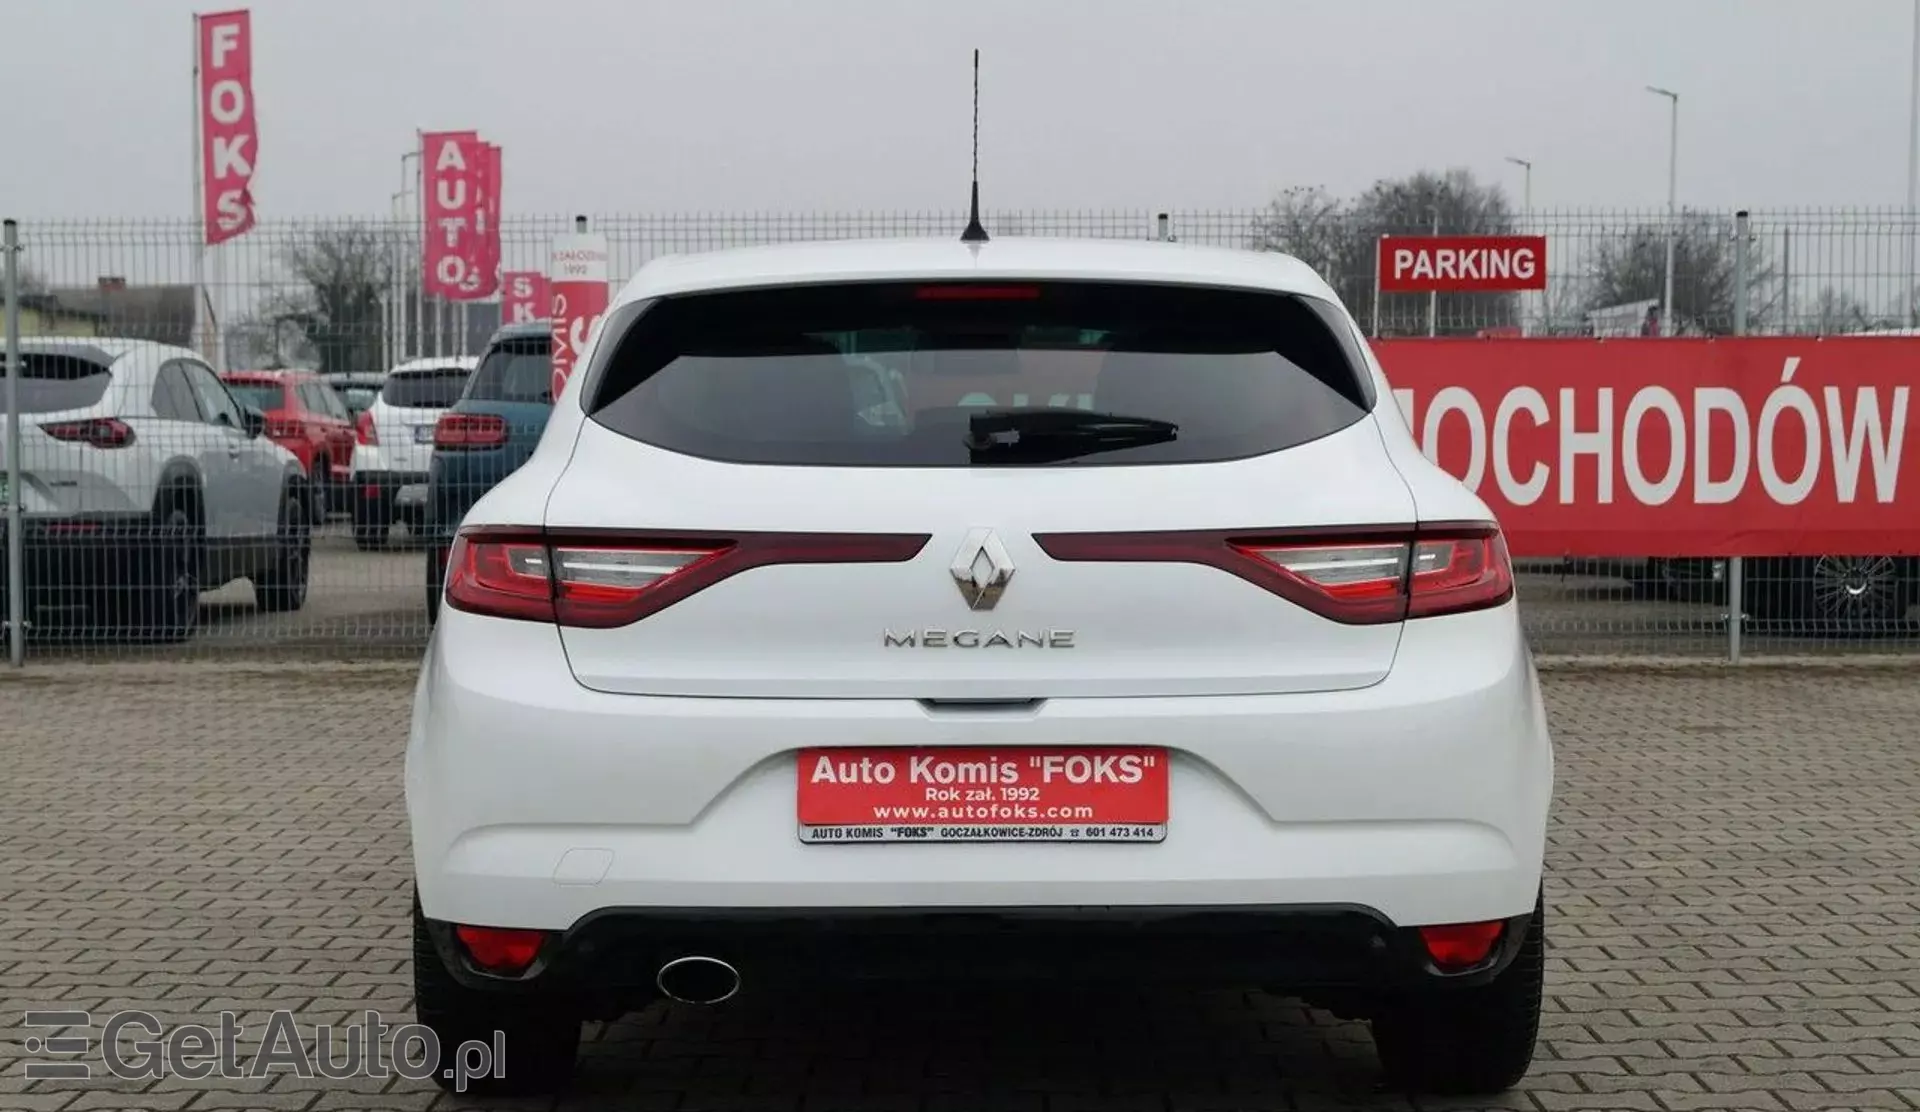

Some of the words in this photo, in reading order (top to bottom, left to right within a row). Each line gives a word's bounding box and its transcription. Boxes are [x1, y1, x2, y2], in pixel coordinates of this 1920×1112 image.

[210, 24, 252, 231] FOKS
[436, 139, 467, 284] AUTO
[1393, 248, 1536, 280] PARKING
[884, 628, 1075, 648] MEGANE
[811, 755, 896, 784] Auto
[910, 755, 1019, 784] Komis
[1030, 755, 1155, 784] "FOKS"
[926, 787, 961, 801] Rok
[965, 787, 996, 801] zał.
[1001, 787, 1040, 801] 1992
[873, 804, 1093, 819] www.autofoks.com
[812, 828, 842, 839] AUTO
[846, 827, 884, 839] KOMIS
[941, 826, 1063, 838] GOCZAŁKOWICE-ZDRÓJ
[1086, 827, 1106, 837] 601
[1110, 827, 1130, 837] 473
[1133, 827, 1154, 837] 414
